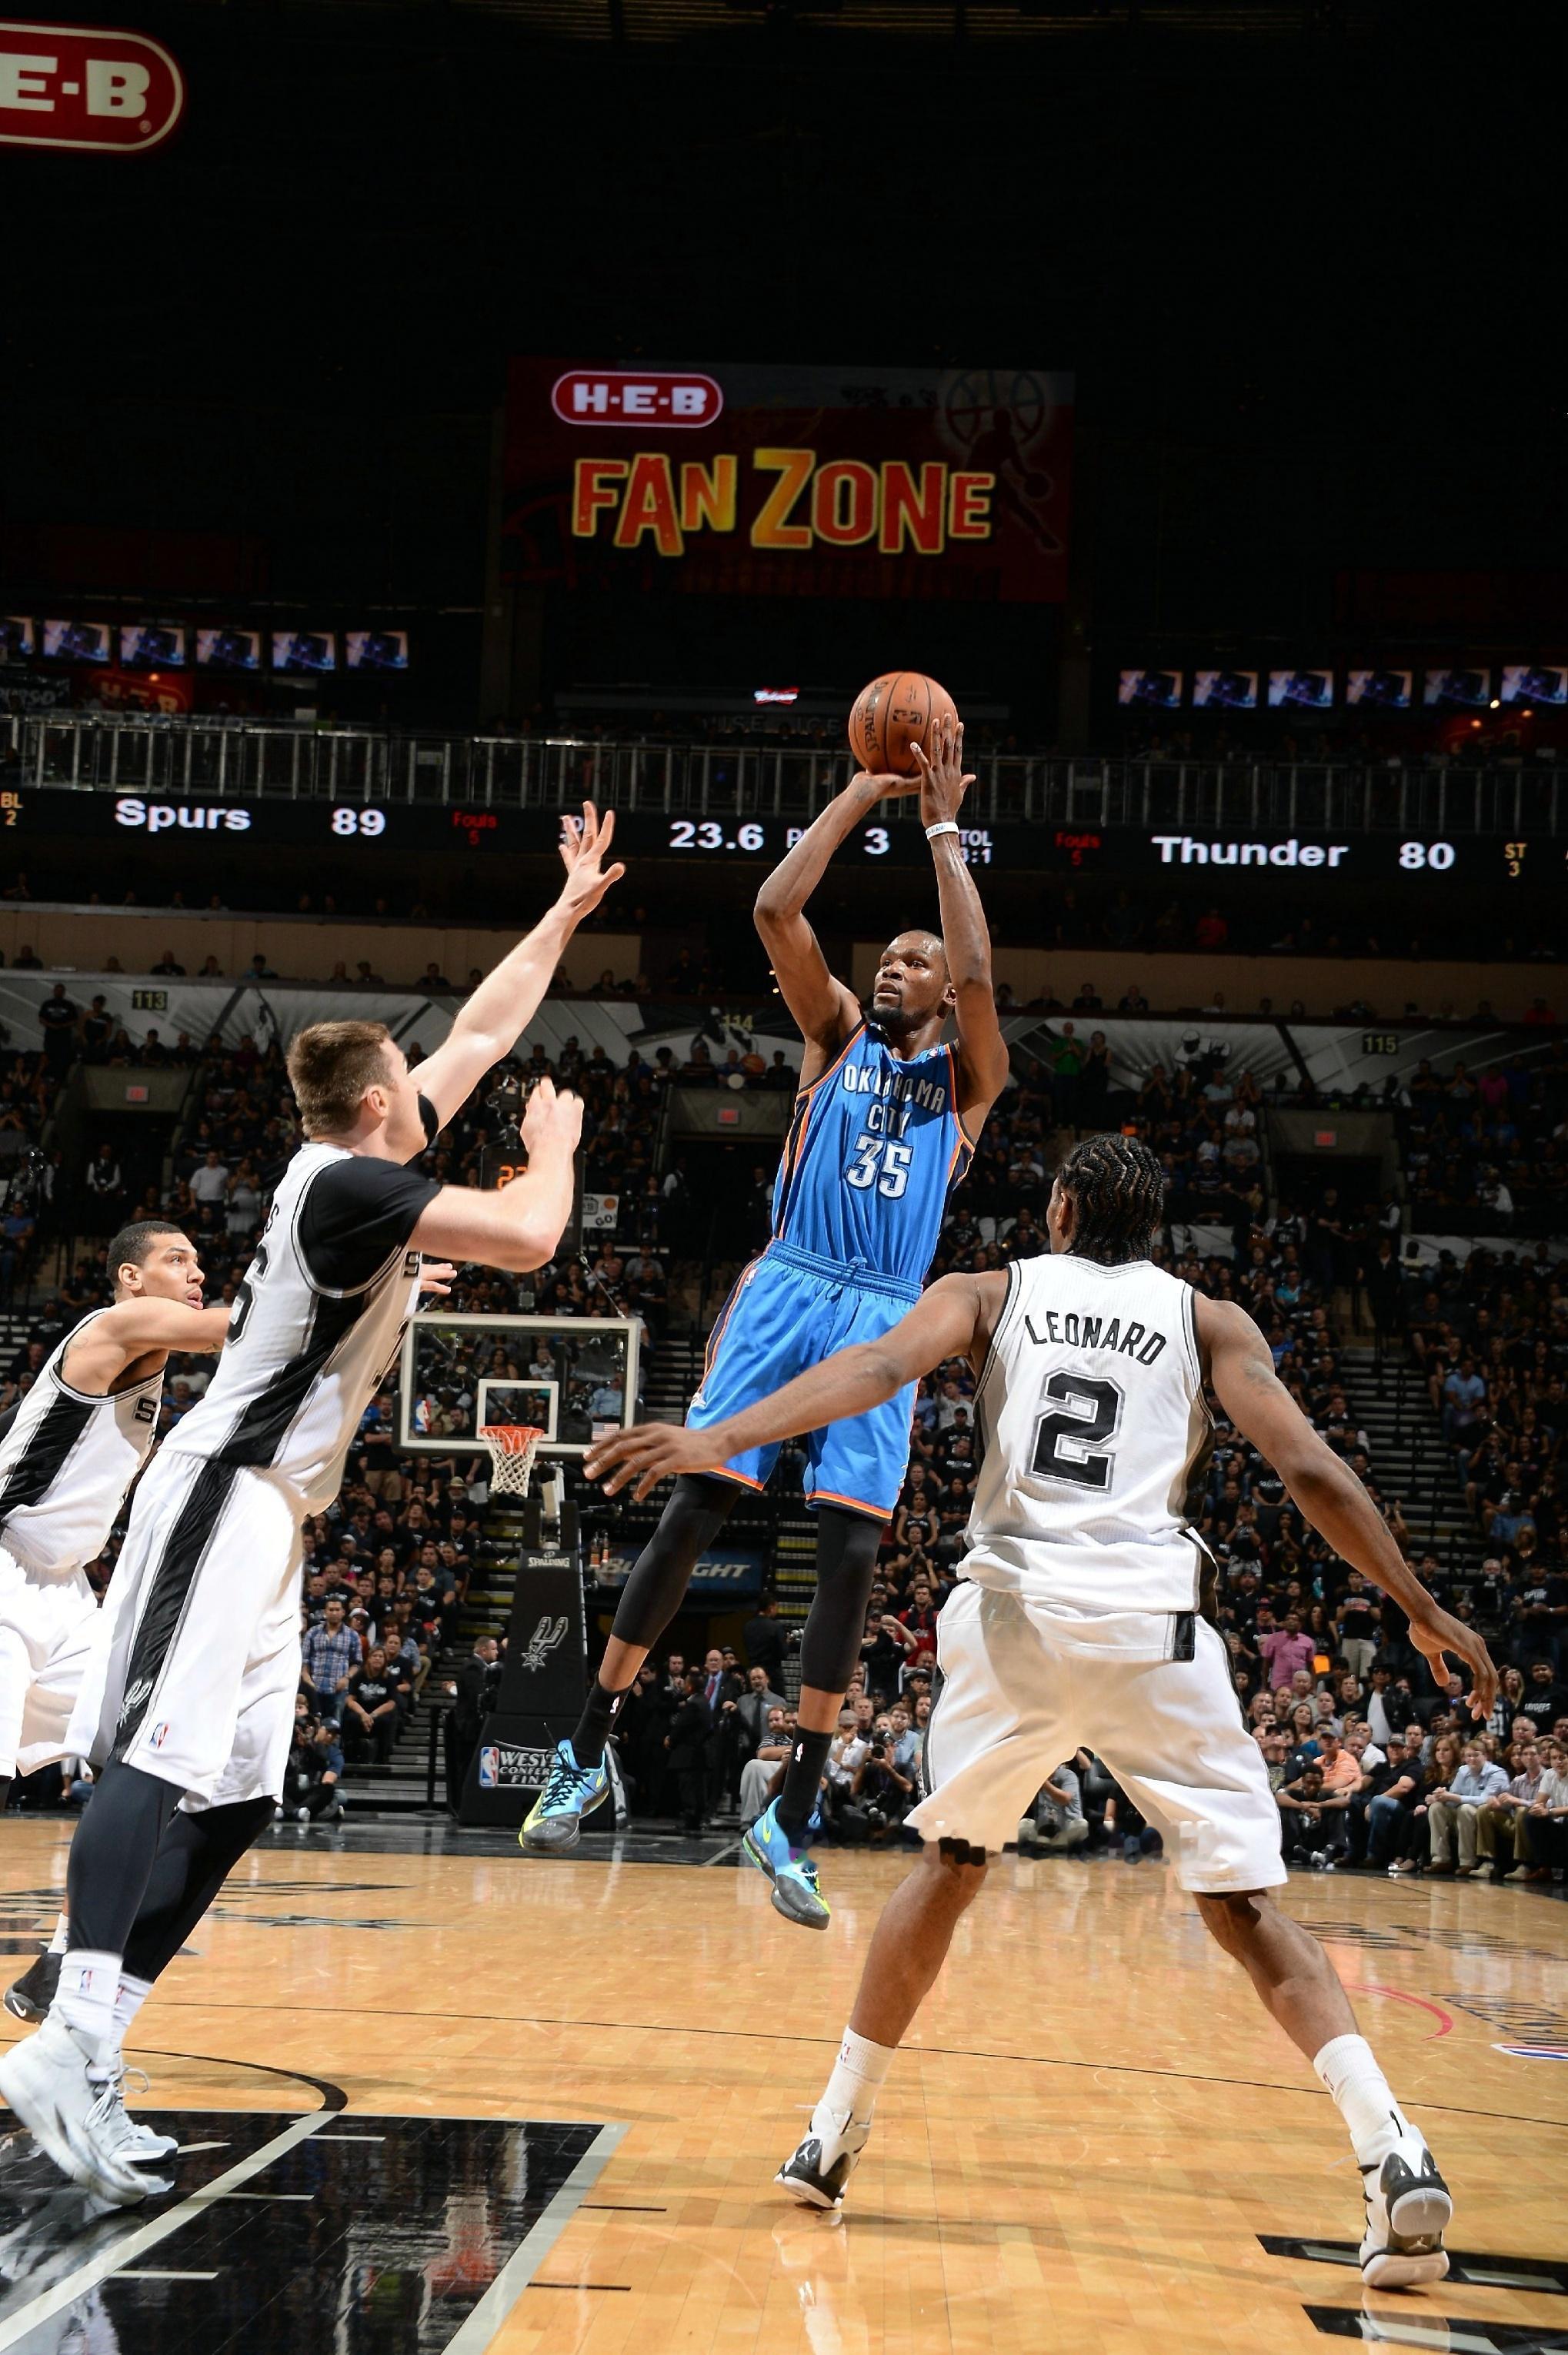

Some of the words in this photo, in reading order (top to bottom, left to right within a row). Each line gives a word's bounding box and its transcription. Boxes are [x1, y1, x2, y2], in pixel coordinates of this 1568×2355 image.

[573, 383, 708, 416] H-E-B
[572, 453, 738, 556] FAN
[750, 447, 996, 554] ZONE
[1, 791, 24, 809] BL
[5, 810, 17, 826] 2
[115, 797, 252, 833] Spurs
[331, 807, 386, 837] 89
[669, 820, 765, 850] 23.6
[864, 827, 889, 856] 3
[1151, 835, 1349, 867] Thunder
[1399, 841, 1456, 870] 80
[1503, 842, 1529, 860] ST
[1508, 860, 1521, 877] 3
[134, 990, 166, 1010] 113
[1363, 1035, 1397, 1054] 115
[843, 1064, 946, 1114] OKLAHOMA
[867, 1103, 911, 1139] CITY
[846, 1132, 914, 1201] 35
[1024, 1310, 1168, 1367] LEONARD
[1023, 1366, 1127, 1495] 2
[527, 1556, 570, 1568] SPALDING
[691, 1562, 752, 1578] GHT
[499, 1766, 552, 1775] CONFER
